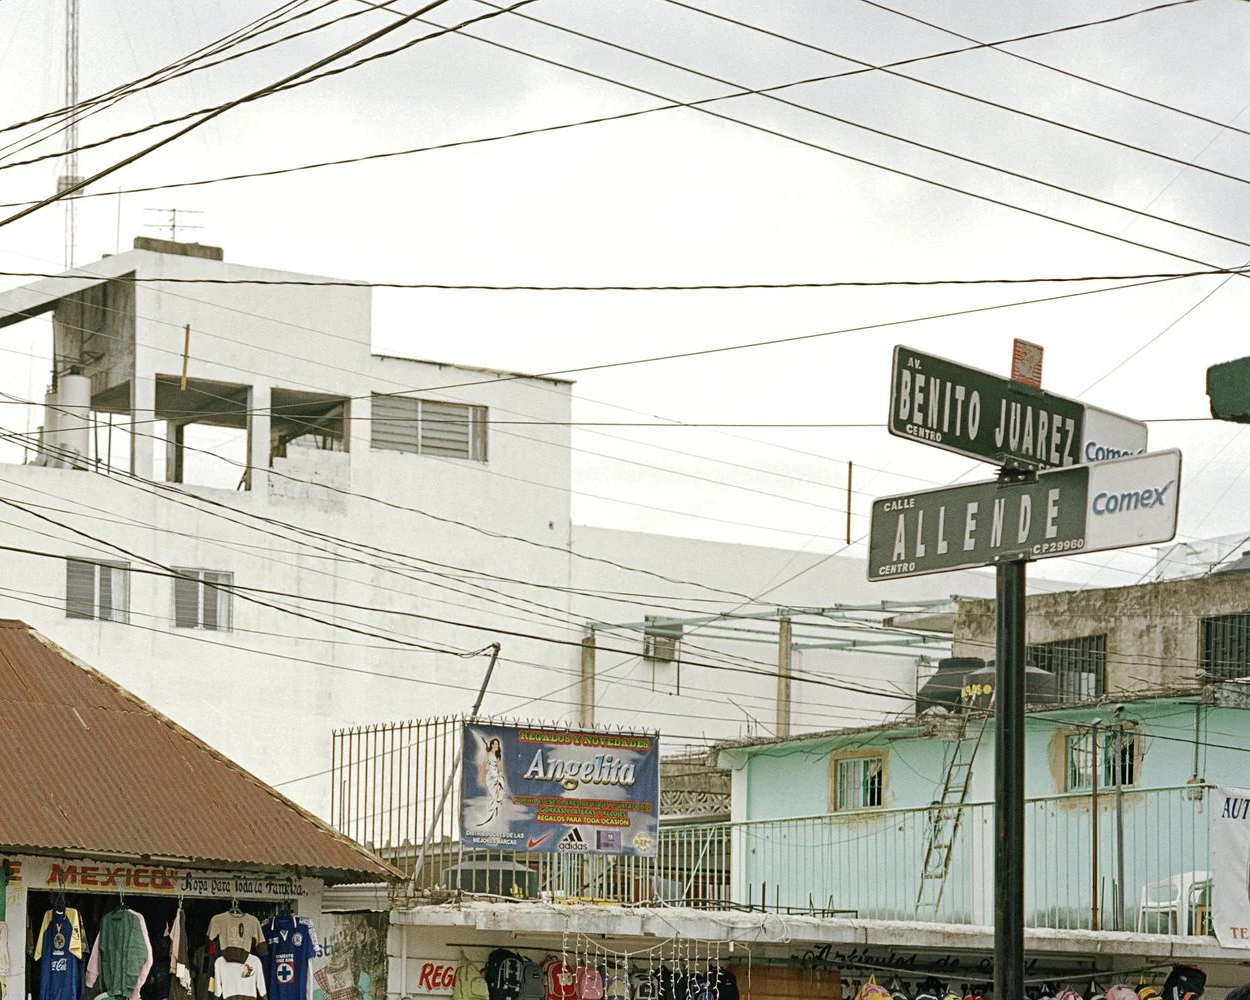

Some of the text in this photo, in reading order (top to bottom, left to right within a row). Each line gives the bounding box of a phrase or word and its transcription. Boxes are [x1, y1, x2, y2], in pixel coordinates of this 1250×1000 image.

[907, 357, 921, 369] AV.
[899, 369, 1075, 465] BENITO JUAREZ
[906, 424, 942, 442] CENTRO
[884, 498, 915, 512] CALLE
[1092, 479, 1175, 516] Comex
[892, 488, 1060, 561] ALLENDE
[878, 562, 915, 575] CENTRO
[520, 732, 570, 742] REGALOS
[584, 737, 649, 749] NOVEDADES
[524, 749, 636, 790] Angelita
[559, 841, 587, 850] adidas
